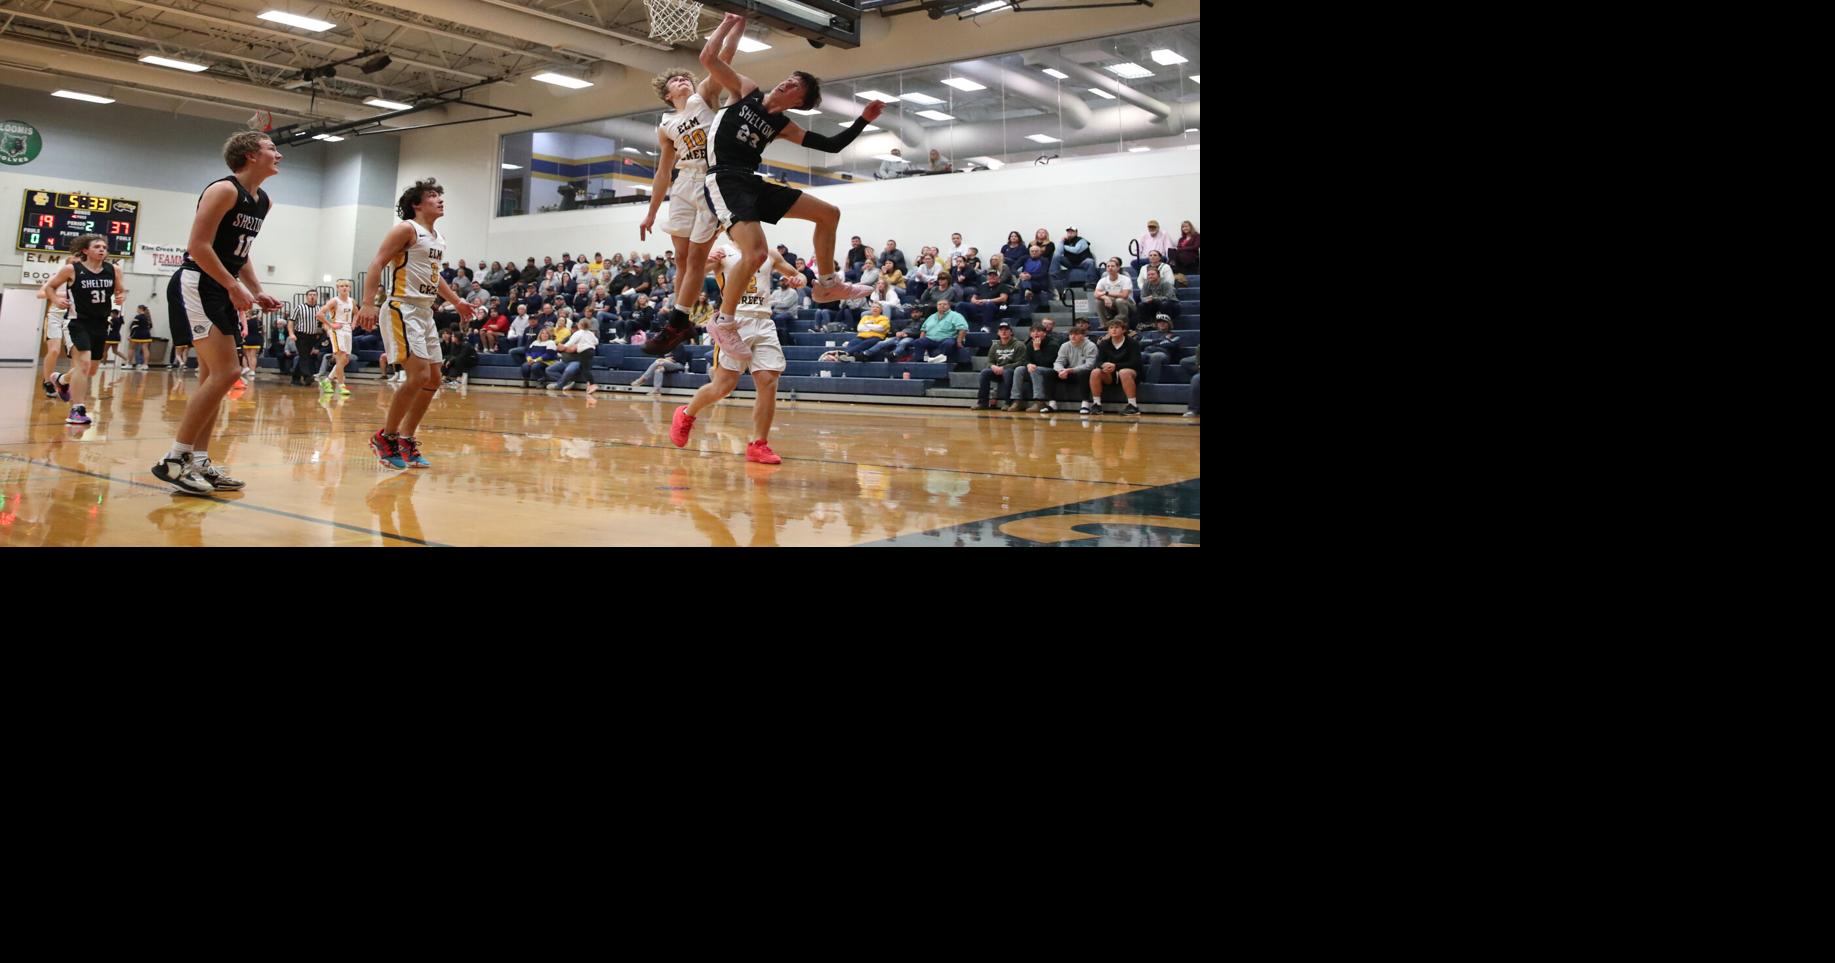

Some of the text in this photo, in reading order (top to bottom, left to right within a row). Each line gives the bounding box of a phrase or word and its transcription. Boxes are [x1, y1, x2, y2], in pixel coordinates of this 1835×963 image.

[677, 116, 700, 134] ELM
[739, 104, 775, 139] SHELTON
[683, 128, 706, 150] 10
[736, 124, 760, 148] 23
[681, 149, 707, 161] REE
[69, 195, 108, 211] 5:33
[38, 214, 54, 228] 19
[85, 221, 95, 231] 2
[110, 220, 130, 234] 37
[30, 233, 40, 244] 0
[47, 237, 54, 245] 4
[26, 252, 60, 264] ELM
[429, 248, 443, 260] ELM
[23, 271, 56, 279] BOO
[81, 279, 113, 289] SHELTON
[91, 290, 106, 304] 31
